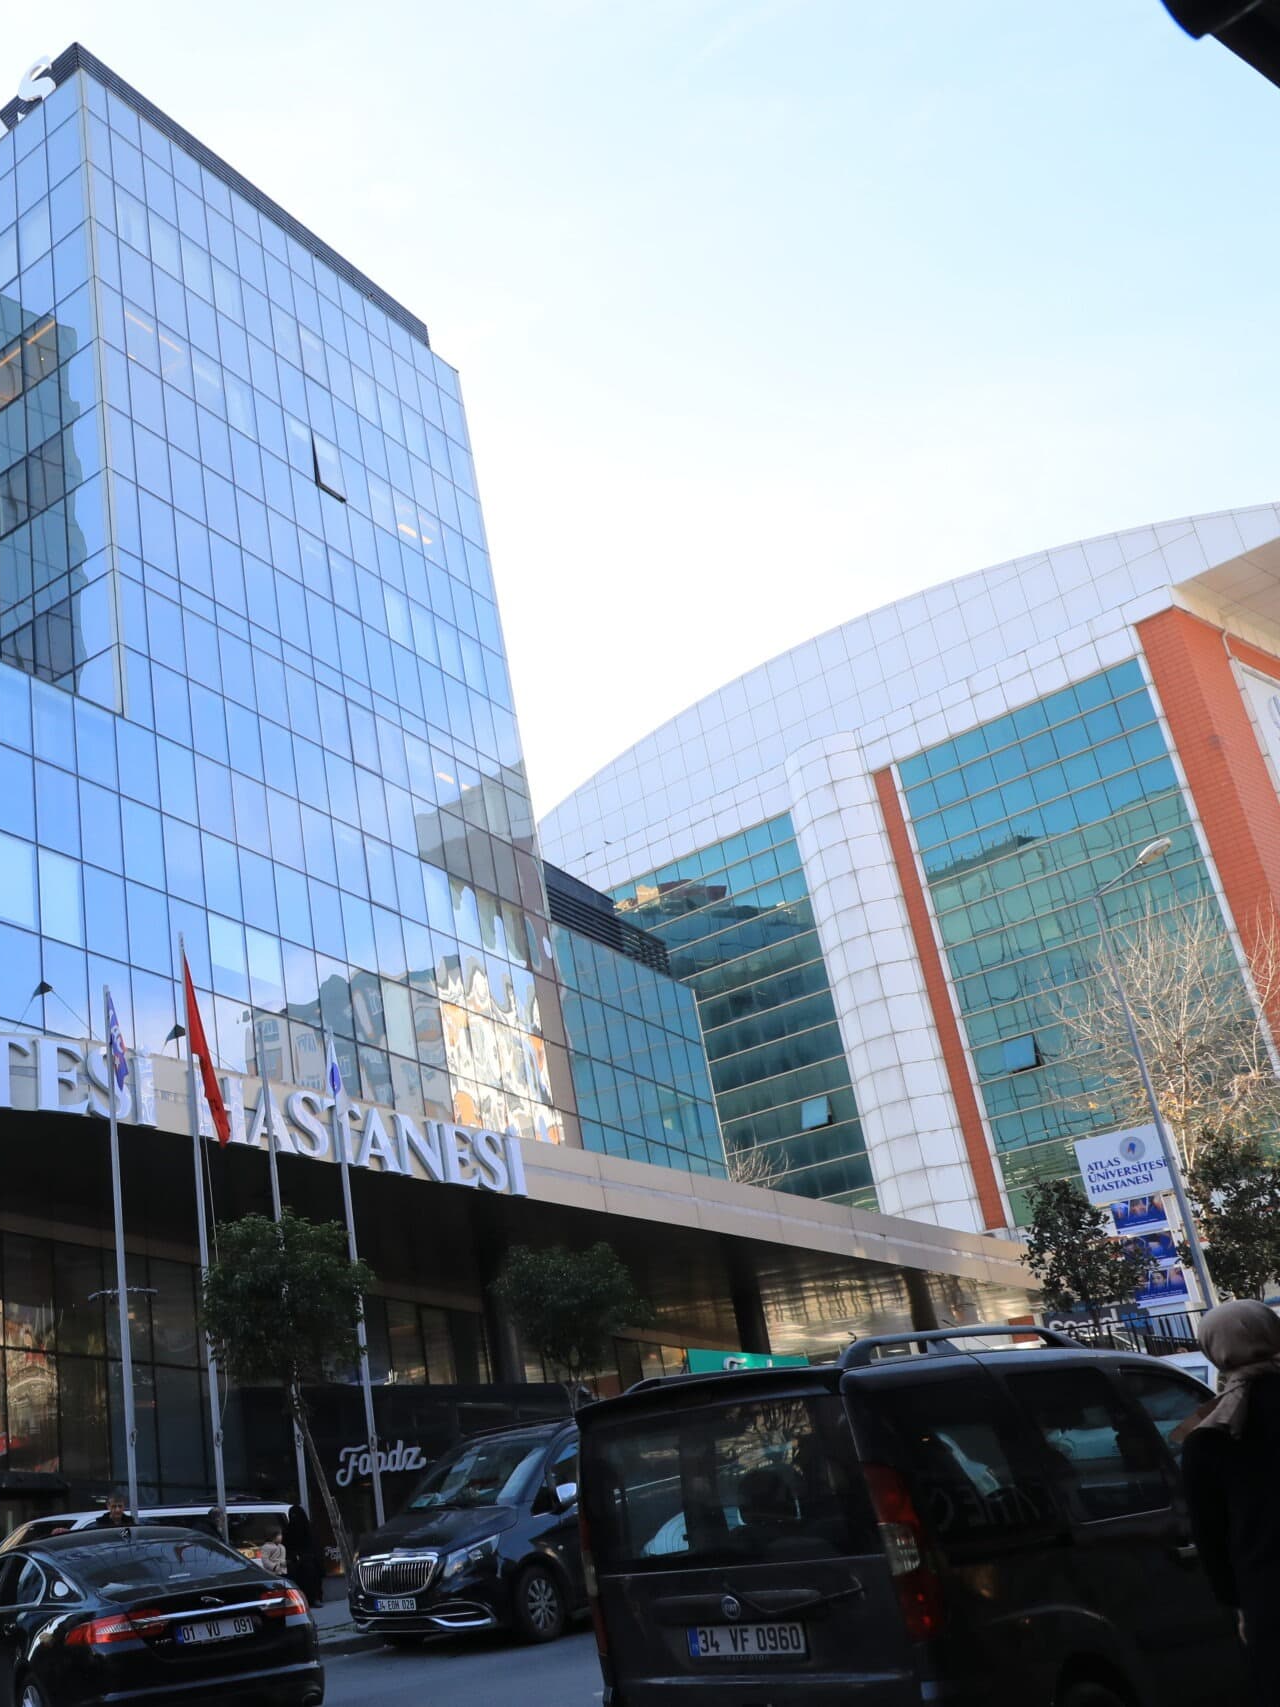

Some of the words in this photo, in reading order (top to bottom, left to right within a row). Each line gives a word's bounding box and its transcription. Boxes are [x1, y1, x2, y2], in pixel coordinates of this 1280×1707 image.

[1087, 1156, 1122, 1173] ATLAS
[1088, 1155, 1169, 1184] ÜNİVERSİTESİ
[1091, 1170, 1154, 1195] HASTANESİ
[182, 1627, 196, 1642] 01
[233, 1616, 253, 1634] 091
[699, 1629, 720, 1654] 34
[729, 1627, 749, 1653] VF
[755, 1625, 802, 1652] 0960
